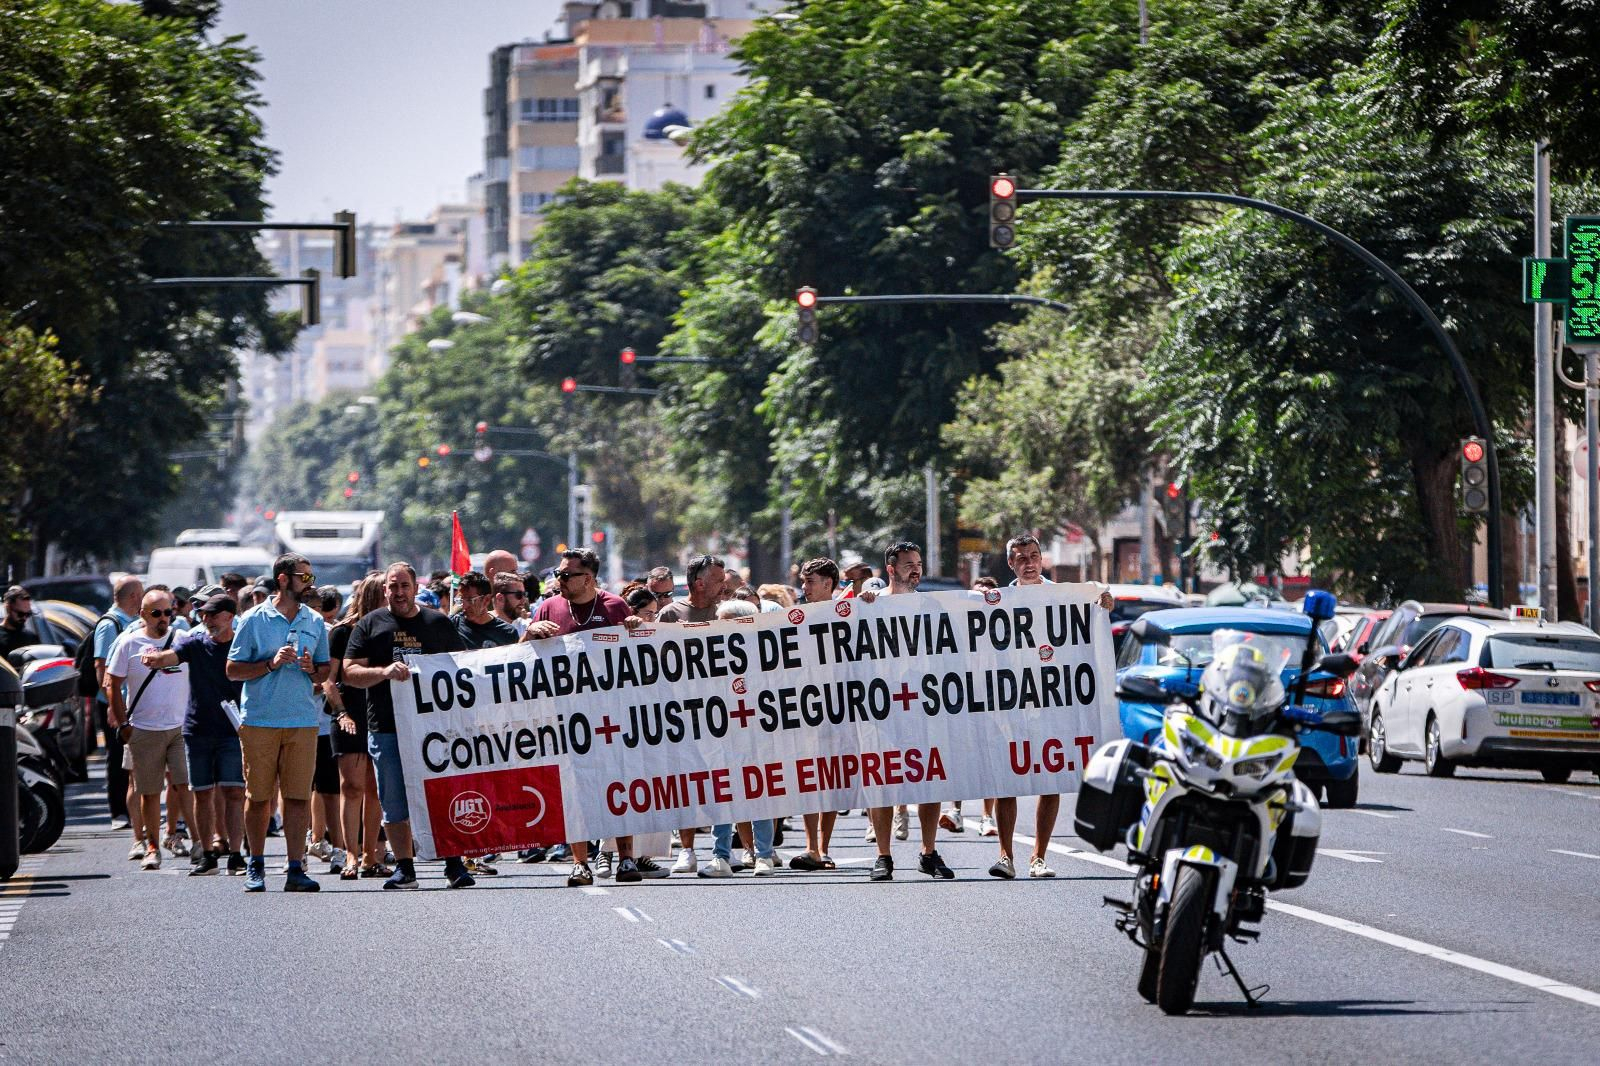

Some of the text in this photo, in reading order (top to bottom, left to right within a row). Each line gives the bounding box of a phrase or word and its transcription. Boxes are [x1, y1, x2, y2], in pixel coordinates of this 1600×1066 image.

[411, 602, 1091, 714] LOS TRABAJADORES DE TRANVIA POR UN
[1492, 692, 1511, 704] SP
[622, 695, 729, 749] JUSTO
[758, 677, 891, 733] SEGURO
[921, 662, 1096, 717] SOLIDARIO
[454, 798, 484, 816] UGT
[606, 735, 1095, 817] COMITE DE EMPRESA U.G.T
